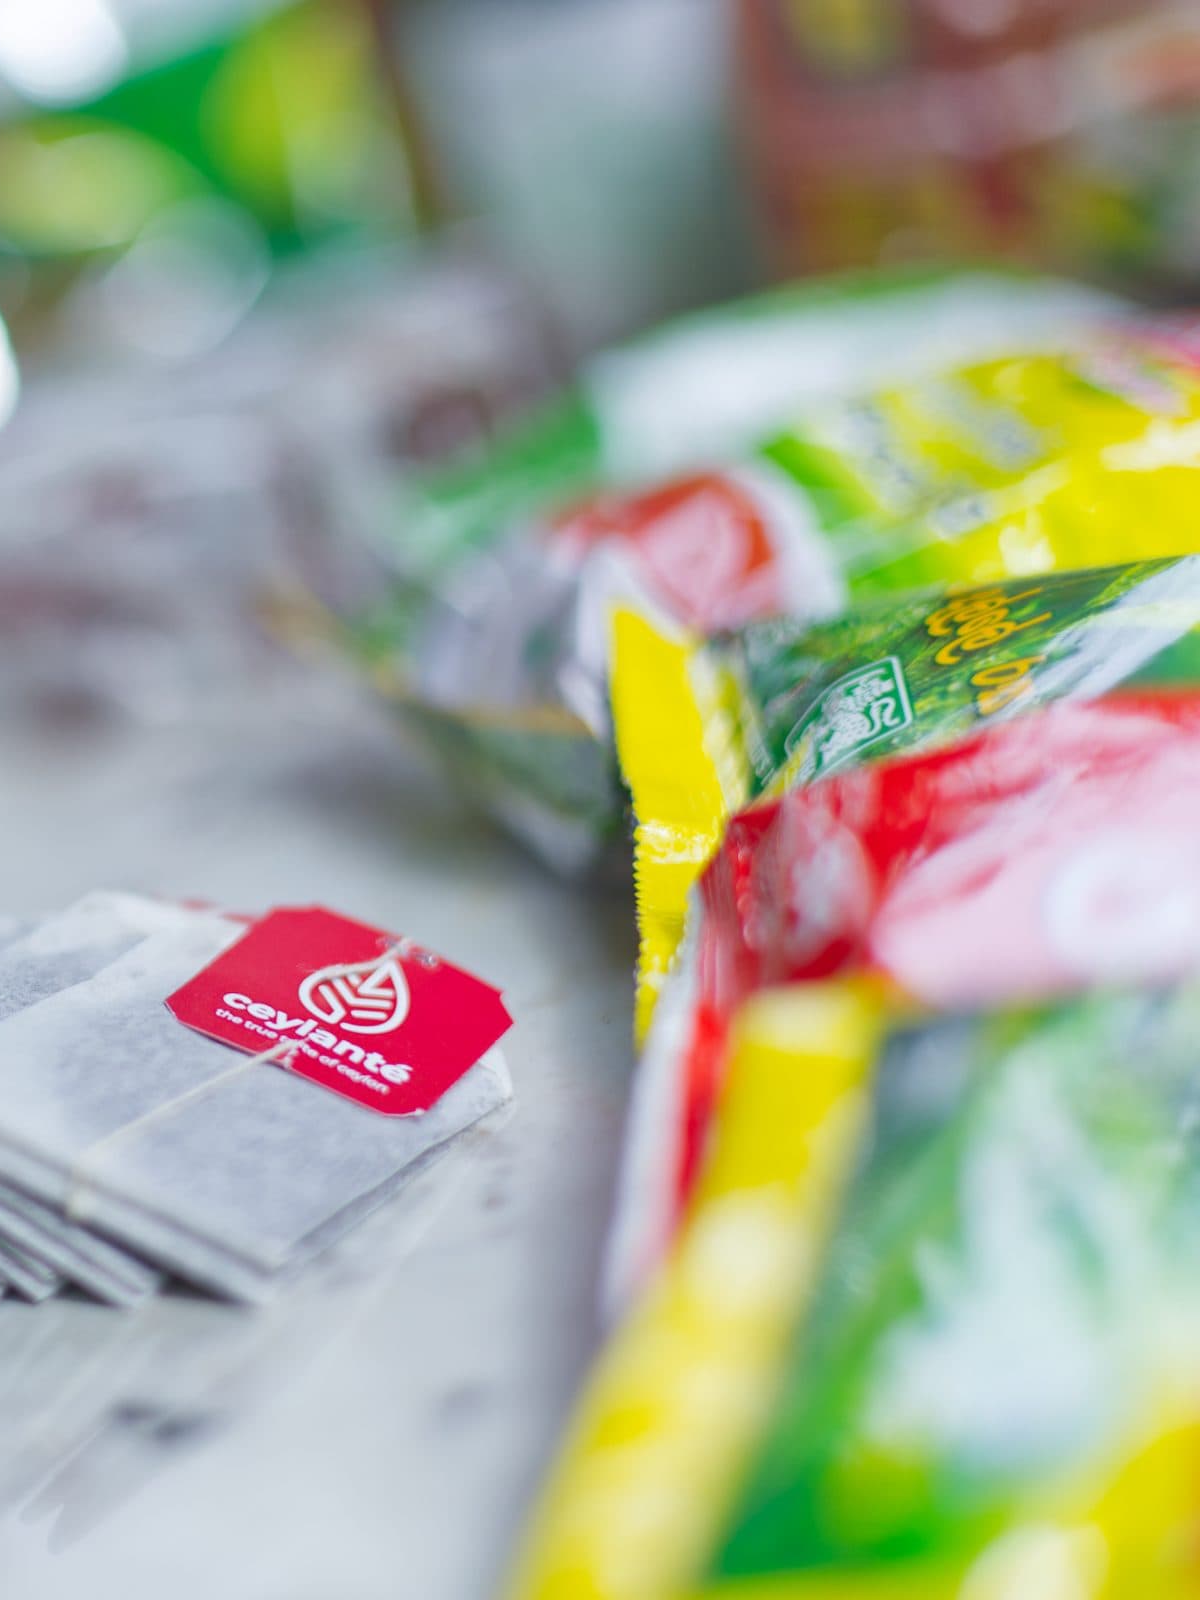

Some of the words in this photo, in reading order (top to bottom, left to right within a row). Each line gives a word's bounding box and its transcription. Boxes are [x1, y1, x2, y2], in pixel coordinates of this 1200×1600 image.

[216, 1008, 243, 1024] the
[244, 1020, 278, 1038] true
[279, 1035, 319, 1059] tte
[319, 1056, 340, 1068] of
[337, 1064, 390, 1095] ceylon
[223, 992, 413, 1085] ceylanté
